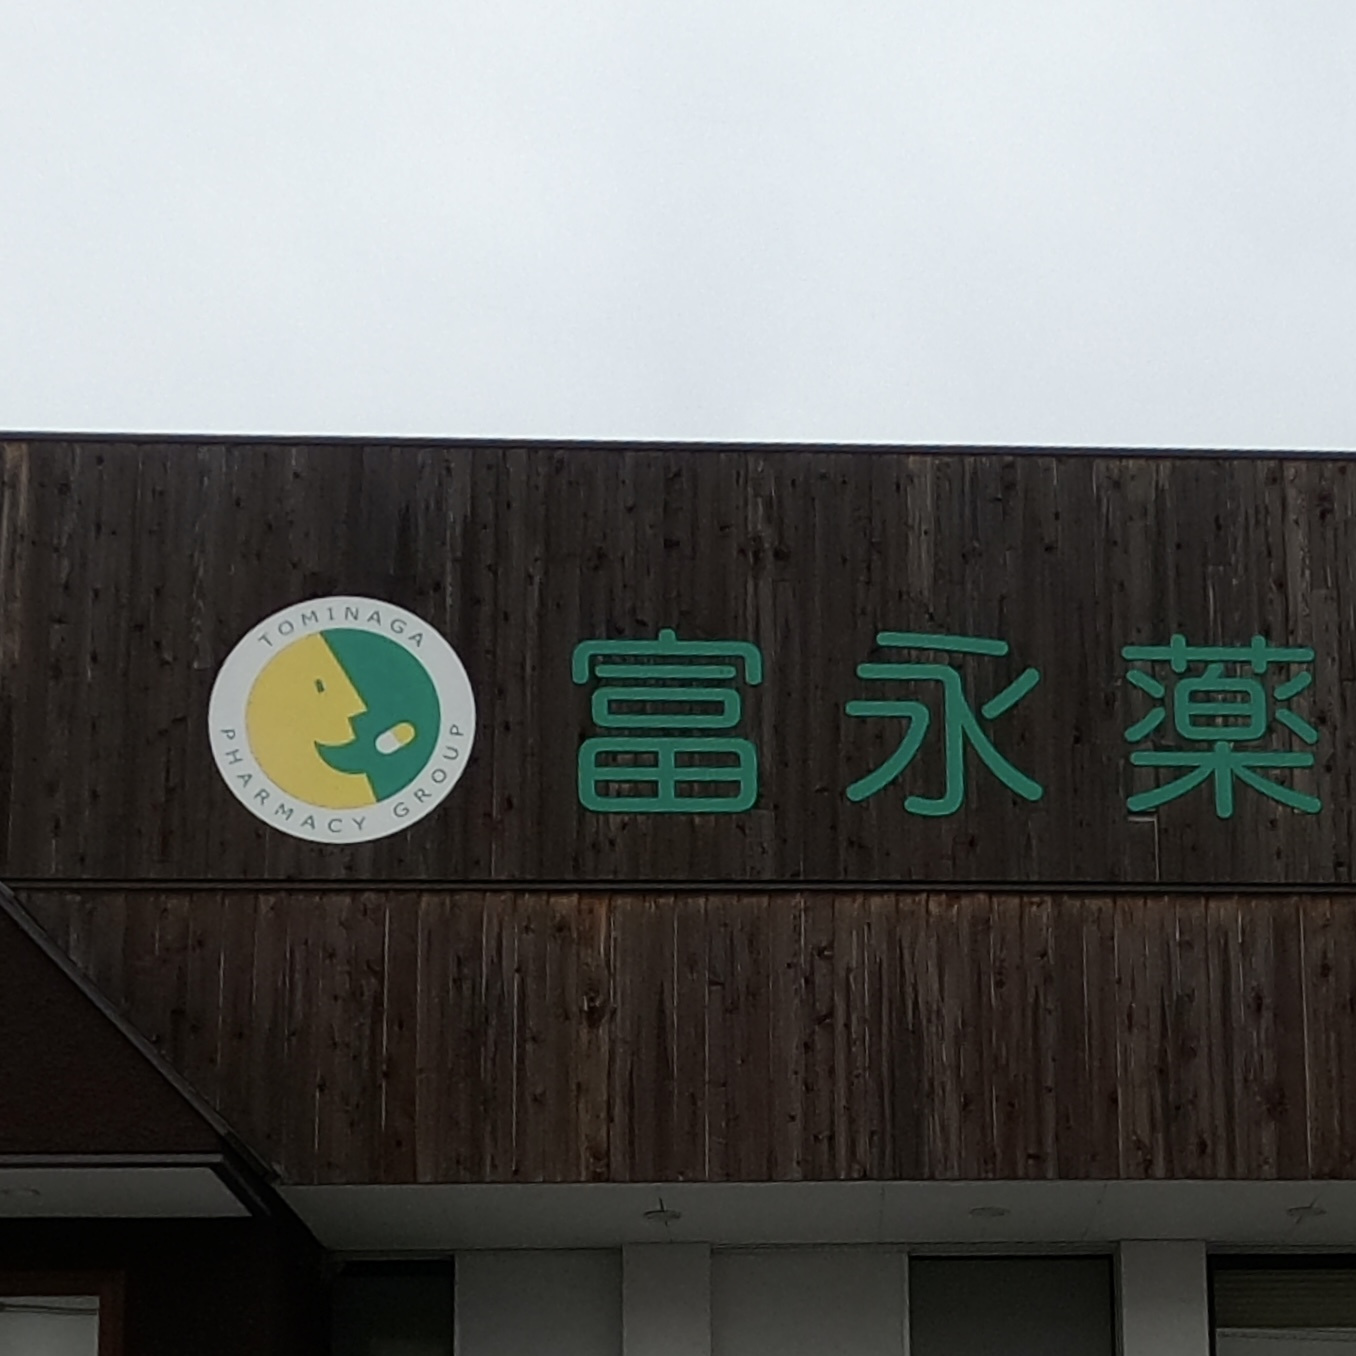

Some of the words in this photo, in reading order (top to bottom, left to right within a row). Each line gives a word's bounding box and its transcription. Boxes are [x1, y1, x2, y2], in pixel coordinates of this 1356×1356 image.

[258, 606, 424, 648] TOMINAGA
[221, 728, 367, 833] PHARMACY
[393, 724, 464, 818] GROUP
